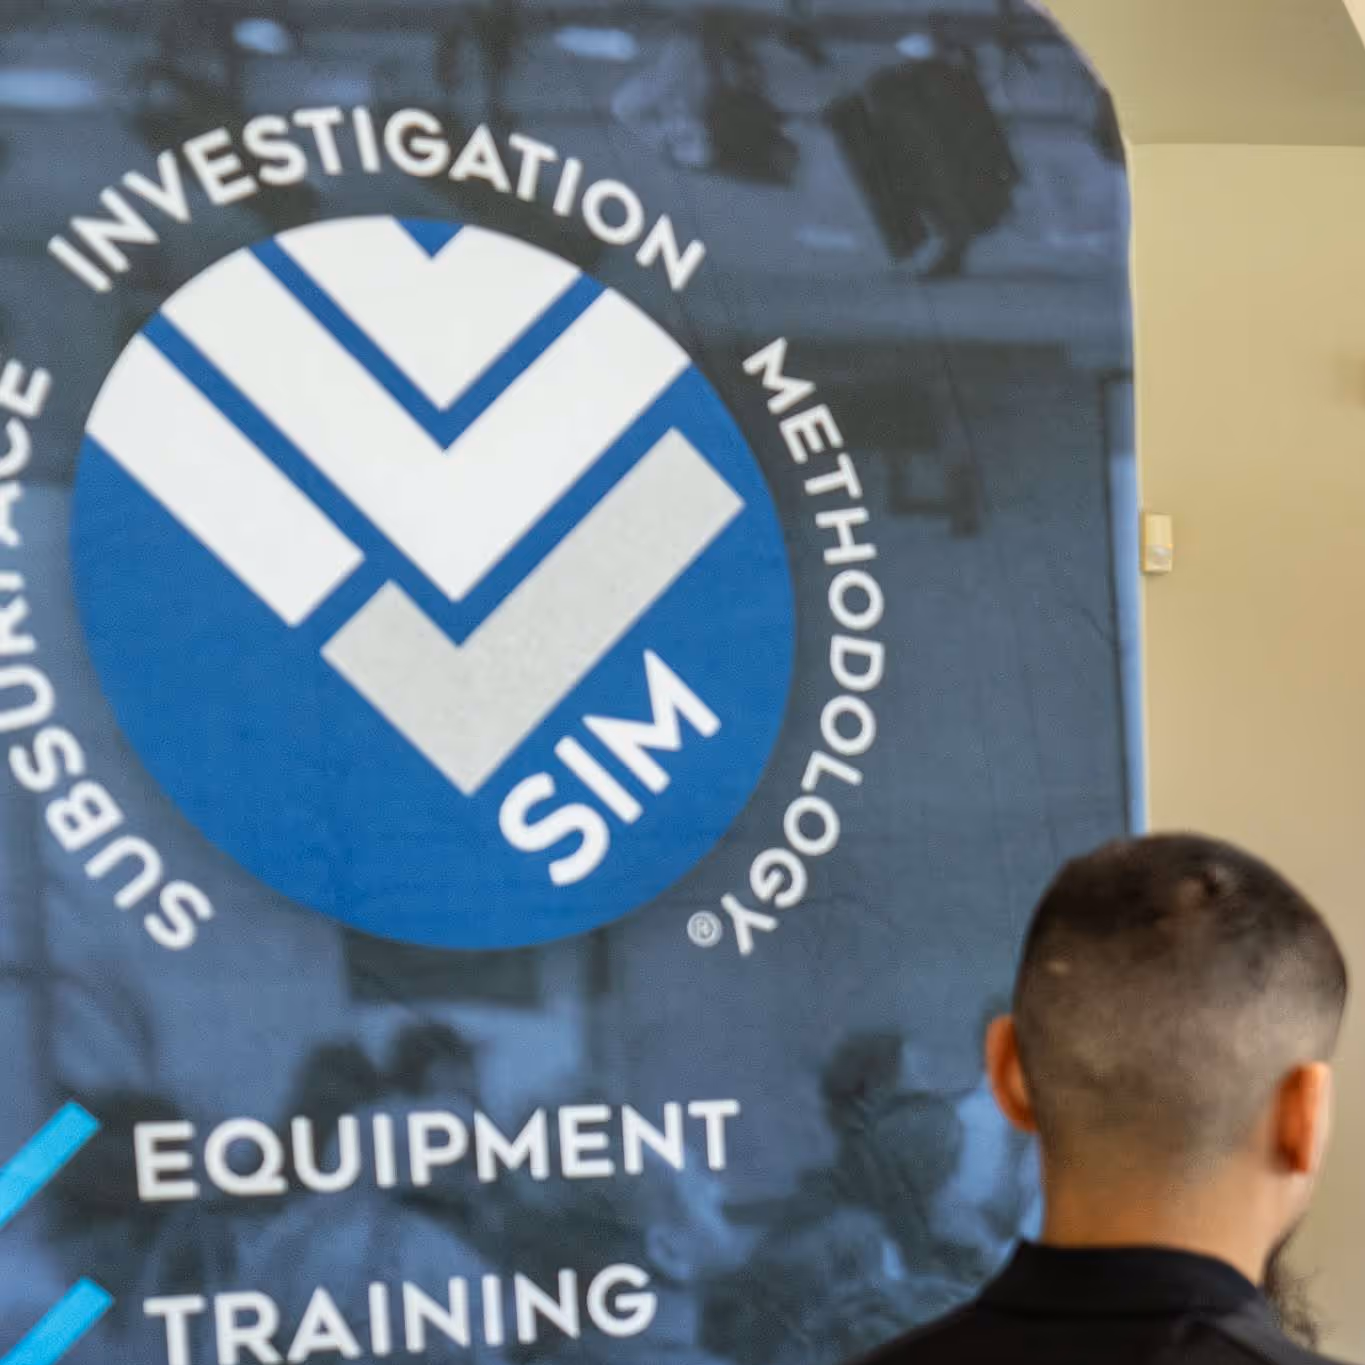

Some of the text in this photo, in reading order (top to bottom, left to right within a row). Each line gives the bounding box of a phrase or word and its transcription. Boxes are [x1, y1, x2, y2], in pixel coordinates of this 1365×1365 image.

[47, 106, 707, 293] INVESTIGATION
[497, 648, 721, 887] SIM
[133, 1098, 742, 1203] EQUIPMENT
